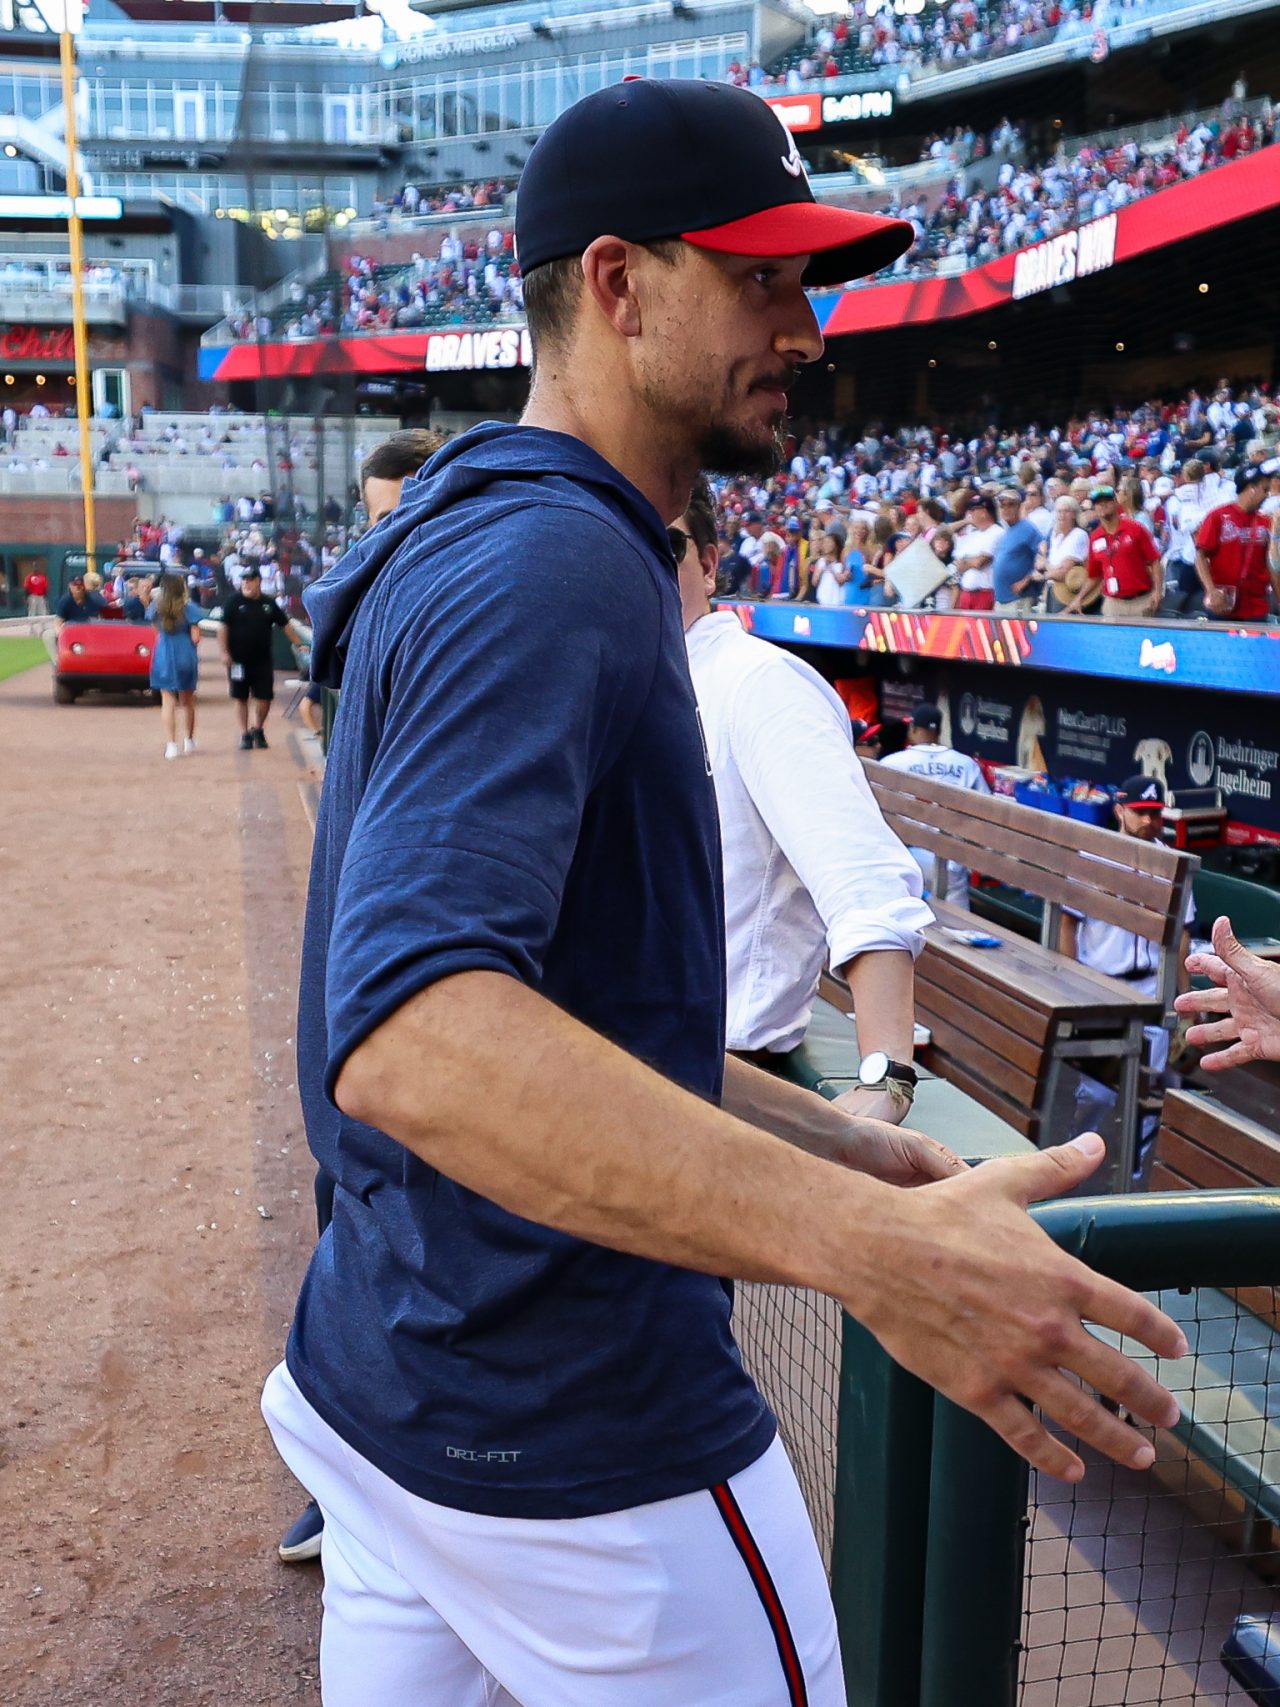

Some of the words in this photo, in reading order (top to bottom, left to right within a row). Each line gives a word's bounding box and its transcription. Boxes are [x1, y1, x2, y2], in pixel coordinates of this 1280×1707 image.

[425, 330, 519, 372] BRAVES
[1217, 736, 1280, 771] Boehringer
[1216, 766, 1271, 799] Ingelheim
[446, 1446, 522, 1463] DRI-FIT
